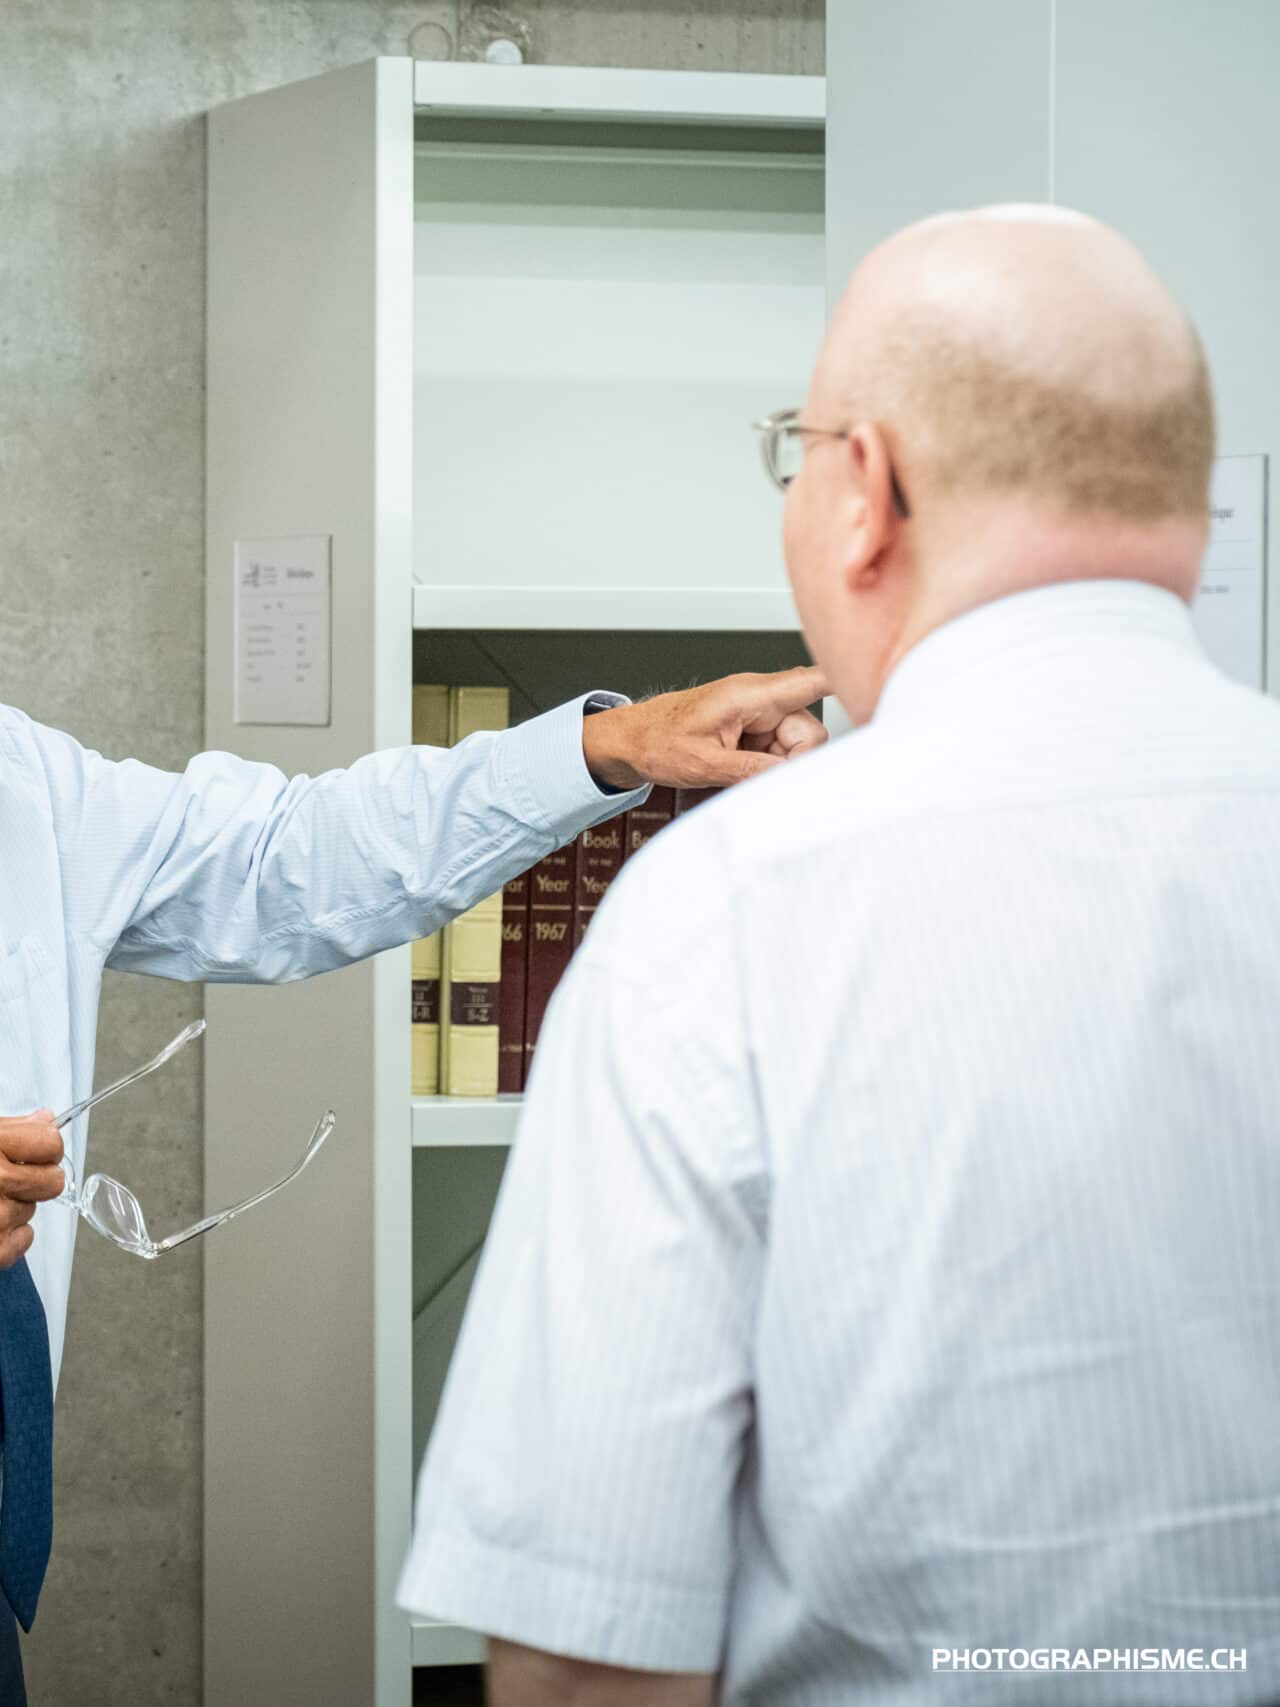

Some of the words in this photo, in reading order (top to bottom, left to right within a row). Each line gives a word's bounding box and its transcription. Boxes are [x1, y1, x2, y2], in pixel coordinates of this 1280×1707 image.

[582, 830, 620, 849] Book
[536, 874, 570, 893] Year
[582, 875, 609, 894] Yea
[503, 923, 523, 941] 66
[535, 922, 568, 941] 1967
